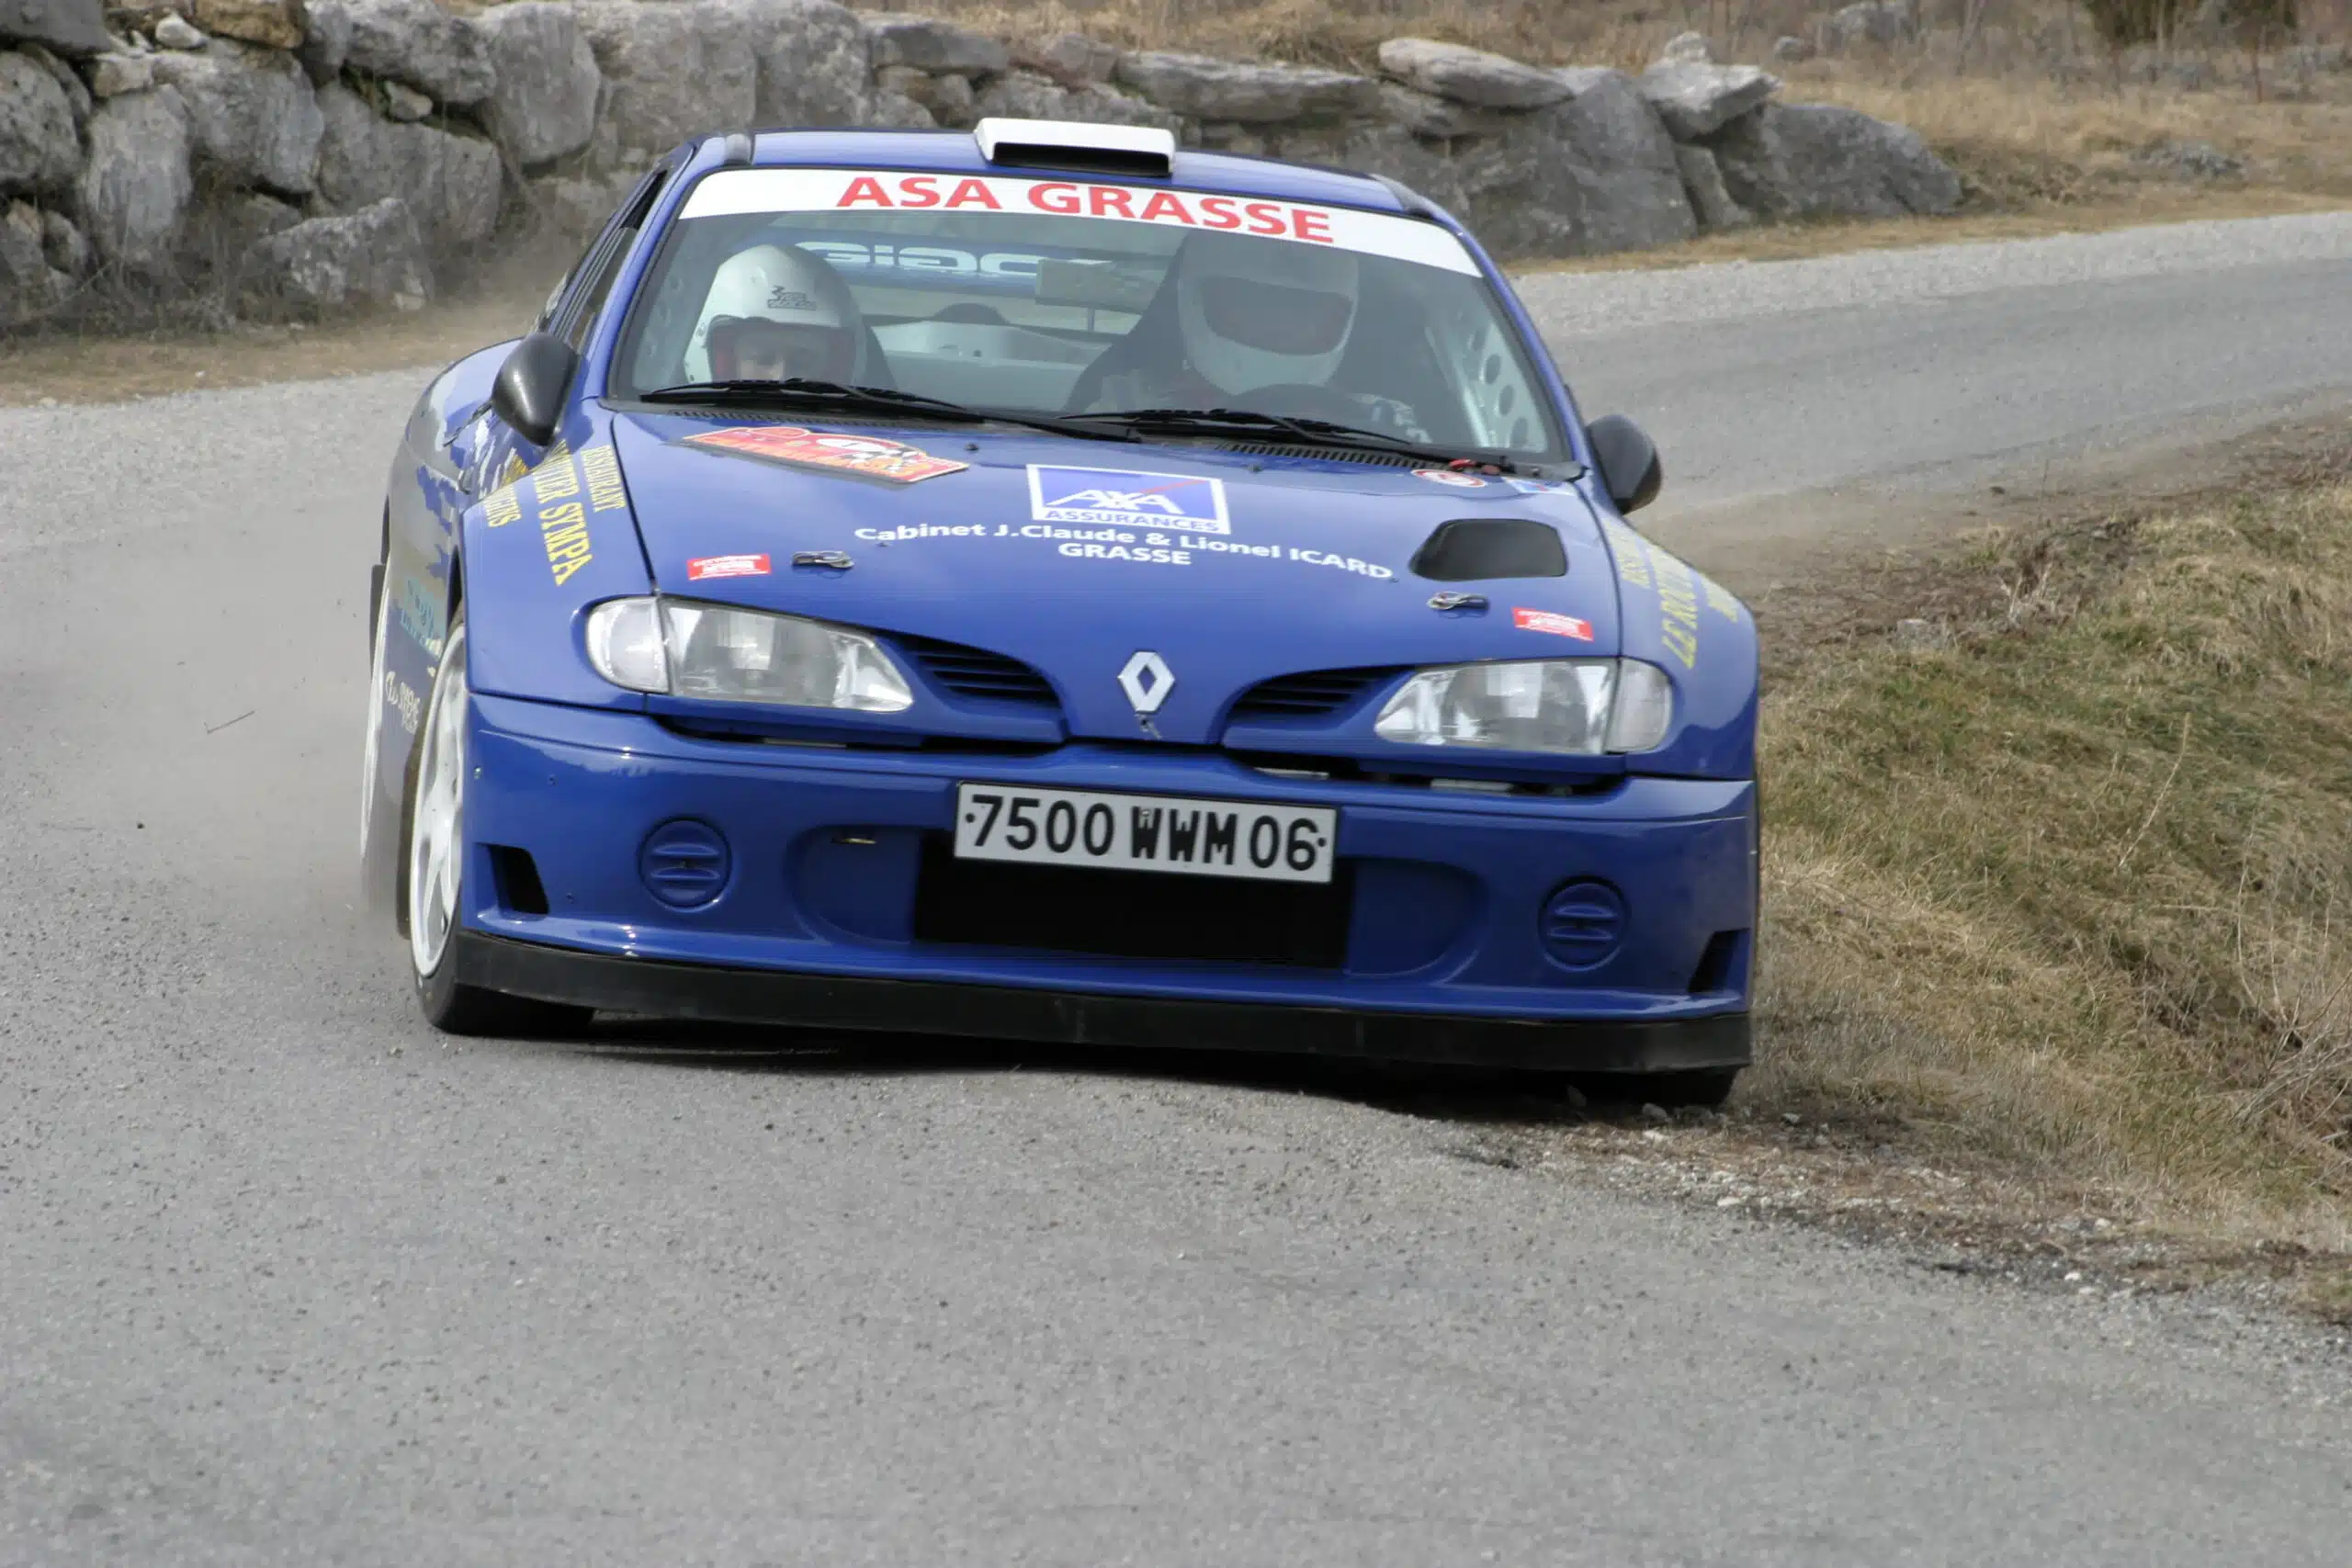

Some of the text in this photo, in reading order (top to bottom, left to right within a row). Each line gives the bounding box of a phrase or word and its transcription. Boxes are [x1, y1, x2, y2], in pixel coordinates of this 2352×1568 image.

[836, 176, 1334, 243] ASA GRASSE
[581, 445, 626, 513] RESTAURANT
[1045, 489, 1186, 514] AXA
[538, 502, 594, 586] SYMPA
[854, 524, 1394, 579] Cabinet J.Claude & Lionel ICARD
[1045, 510, 1220, 532] ASSURANCES
[1057, 542, 1192, 565] GRASSE
[970, 794, 1318, 872] 7500 WWM 06
